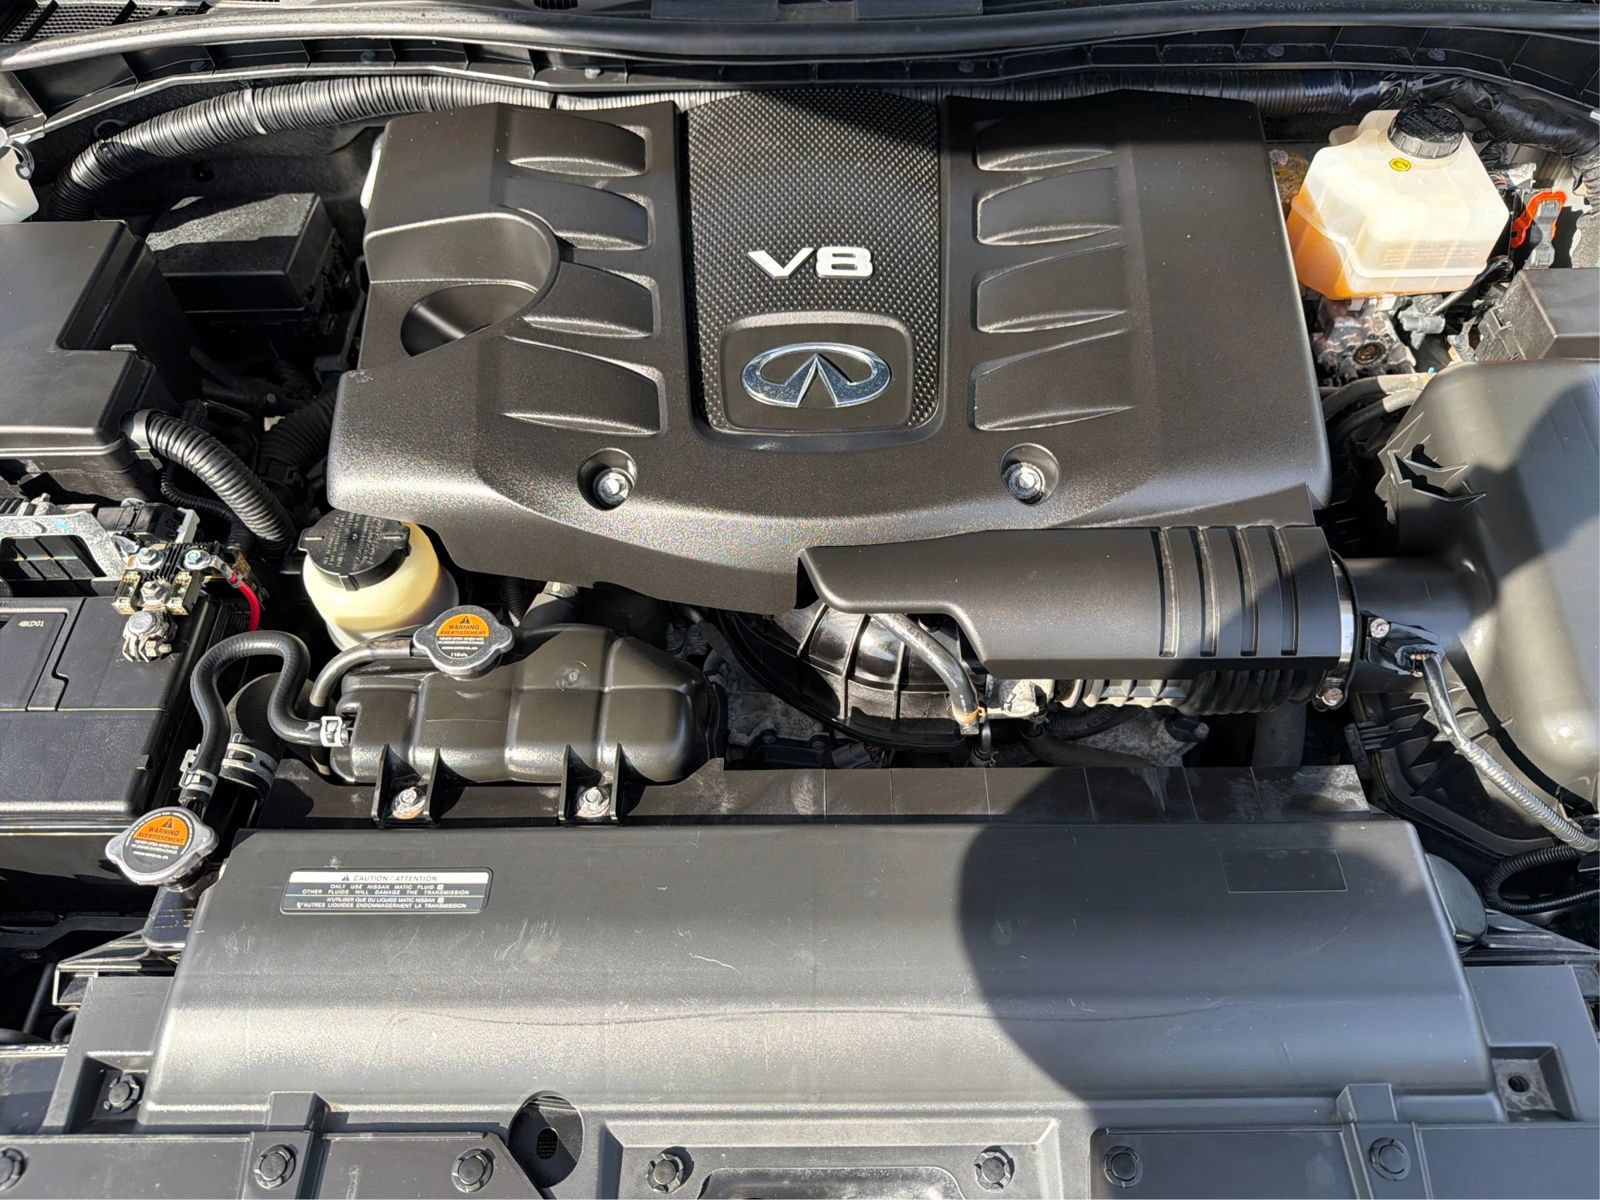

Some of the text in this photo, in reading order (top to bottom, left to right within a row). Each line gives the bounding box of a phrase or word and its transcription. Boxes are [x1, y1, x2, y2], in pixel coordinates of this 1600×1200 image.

[747, 246, 874, 279] V8
[148, 827, 180, 836] WARNING
[137, 832, 184, 843] AVERTISSEMENT
